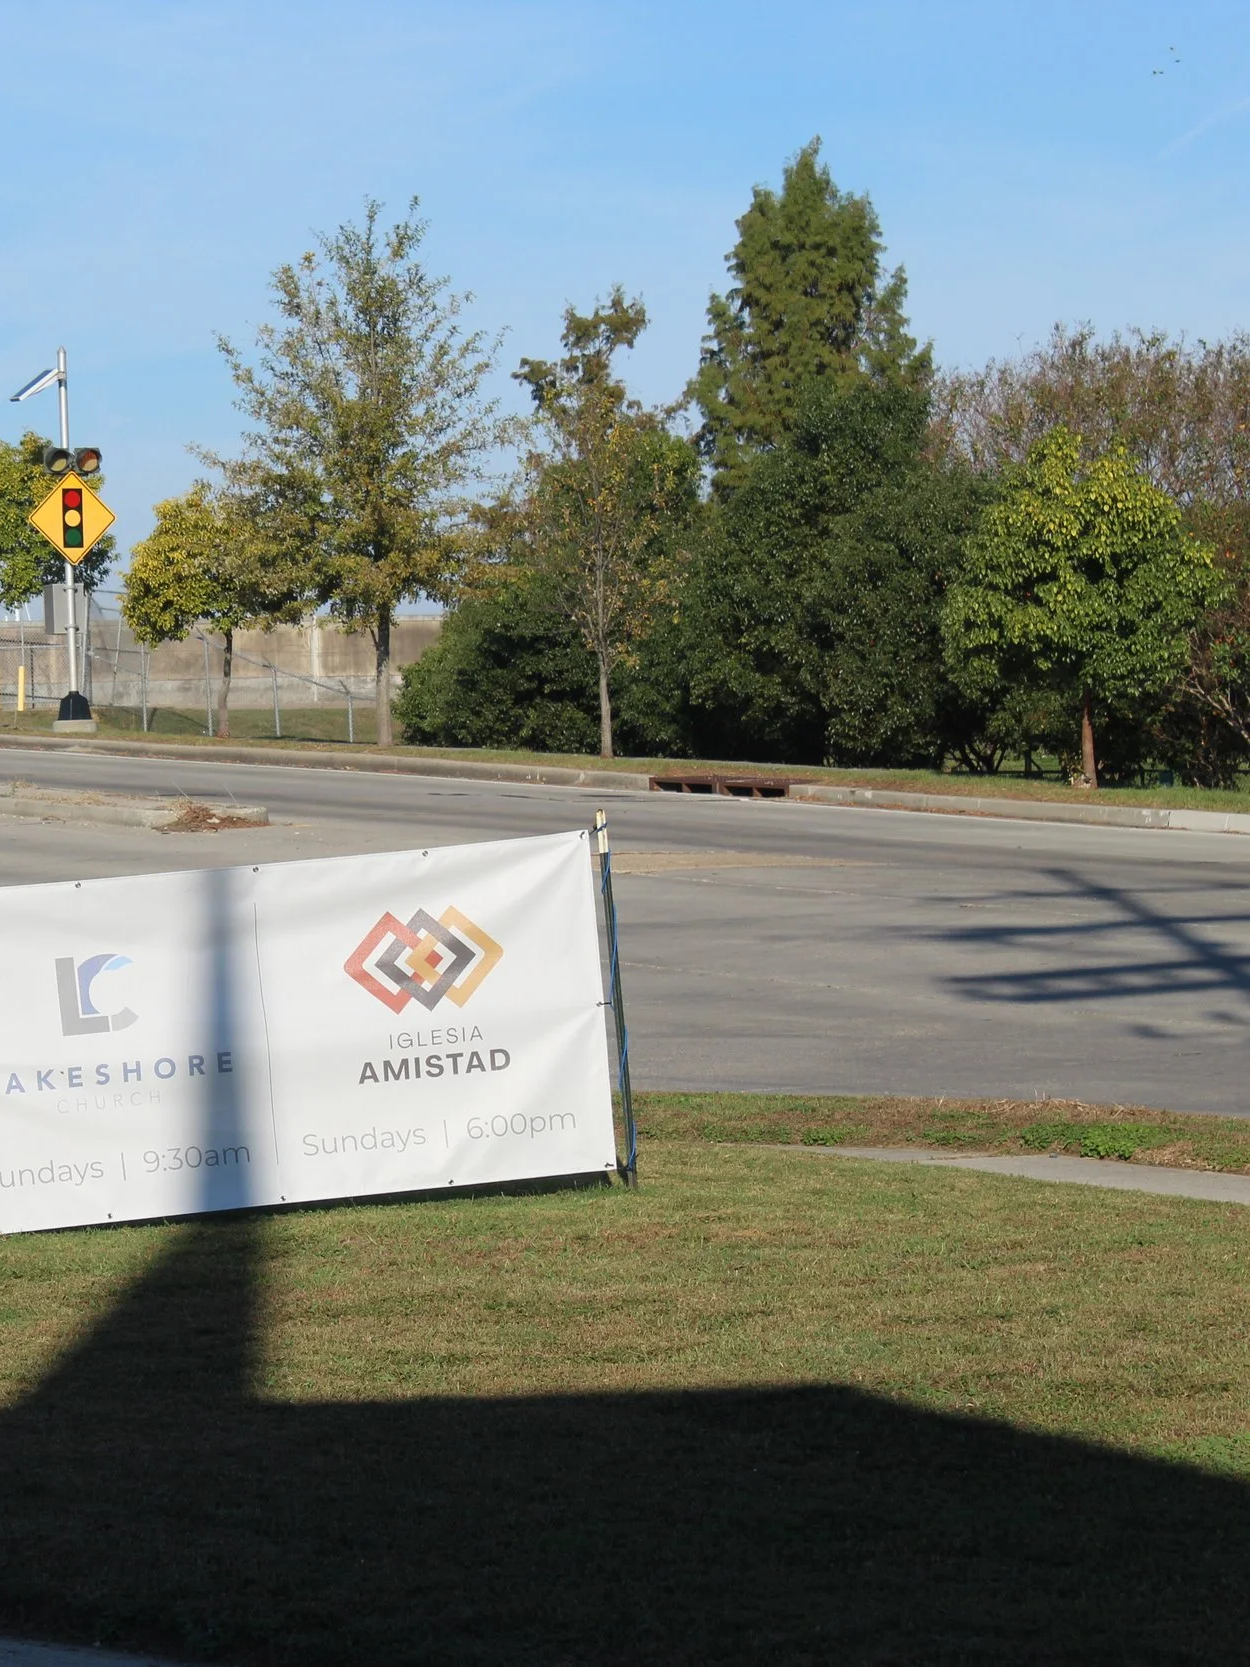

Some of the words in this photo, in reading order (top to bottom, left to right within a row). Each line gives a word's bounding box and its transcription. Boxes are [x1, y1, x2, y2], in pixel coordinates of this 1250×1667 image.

[389, 1025, 484, 1050] IGLESIA
[358, 1048, 511, 1084] AMISTAD
[56, 1090, 162, 1114] CHURCH
[301, 1126, 427, 1156] Sundays
[466, 1112, 577, 1139] 6:00pm
[142, 1146, 251, 1174] 9:30am
